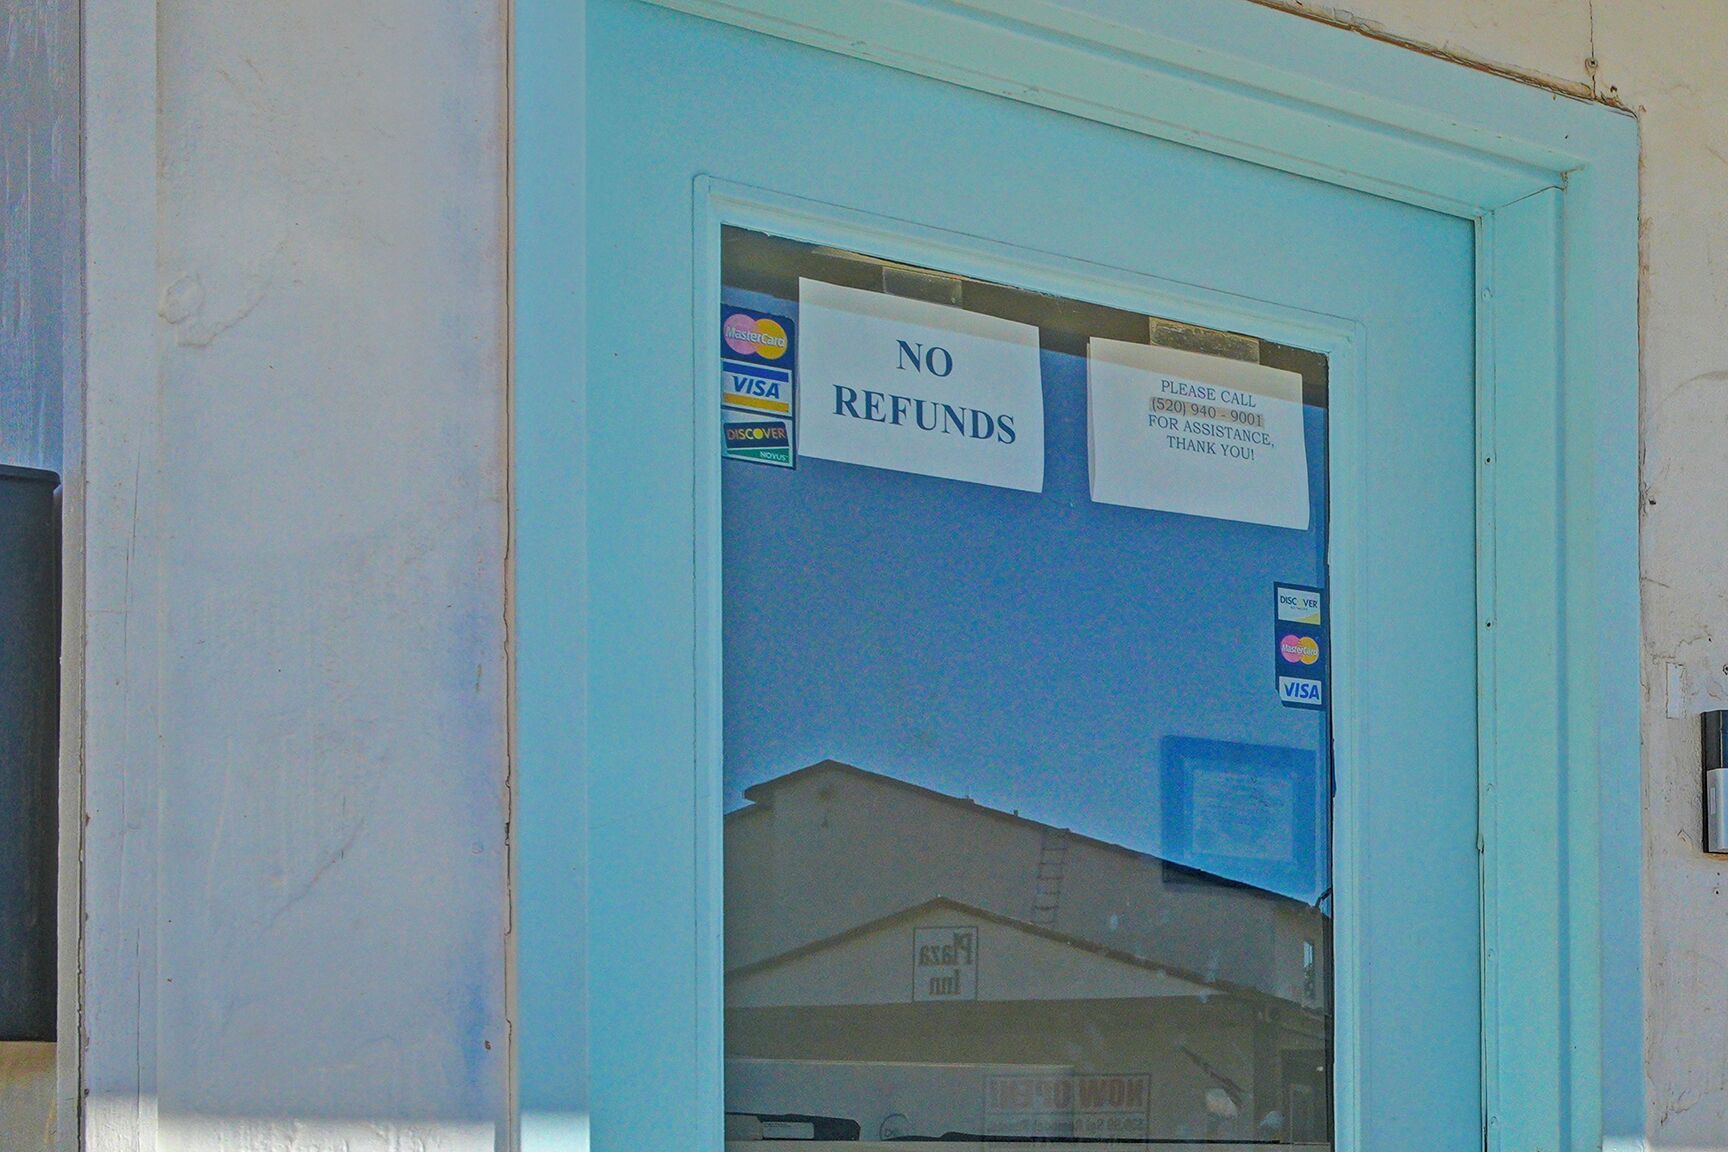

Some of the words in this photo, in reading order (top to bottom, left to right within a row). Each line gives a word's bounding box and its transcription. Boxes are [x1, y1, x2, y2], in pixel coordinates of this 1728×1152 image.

[726, 326, 785, 347] MasterCard
[896, 339, 953, 377] NO
[732, 375, 780, 399] VISA
[1161, 379, 1216, 401] PLEASE
[1221, 390, 1256, 408] CALL
[833, 384, 1016, 444] REFUNDS
[1152, 397, 1186, 416] (520)
[1191, 404, 1216, 419] 940
[1230, 410, 1263, 427] 9001
[727, 427, 786, 441] DISCOVER
[1148, 414, 1179, 431] FOR
[1183, 420, 1275, 448] ASSISTANCE,
[1167, 435, 1216, 455] THANK
[1220, 444, 1255, 461] YOU!
[1282, 643, 1318, 656] MasterCard
[1285, 682, 1320, 700] VISA
